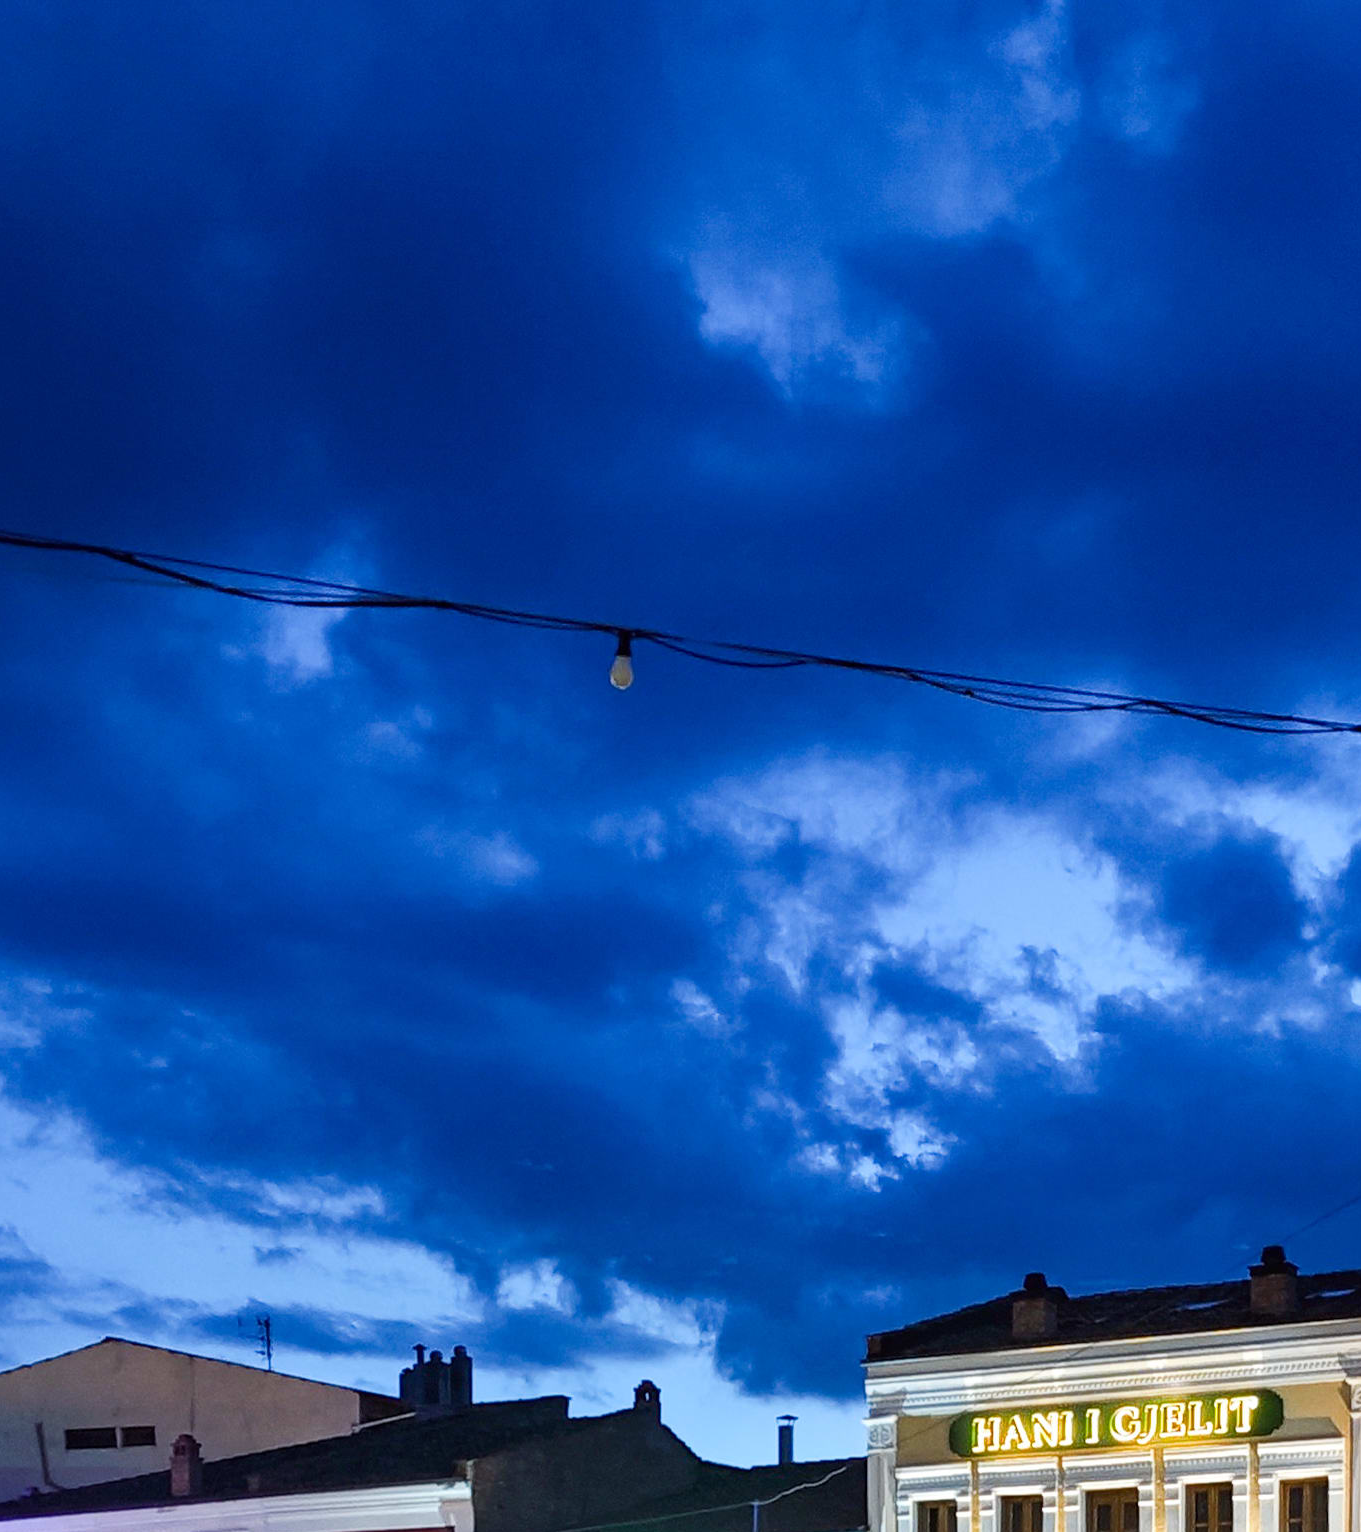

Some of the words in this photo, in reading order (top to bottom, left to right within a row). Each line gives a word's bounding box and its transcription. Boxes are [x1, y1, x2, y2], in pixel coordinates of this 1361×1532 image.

[971, 1410, 1074, 1453] HANI
[1084, 1408, 1101, 1445] I
[1109, 1395, 1260, 1445] GJELIT
